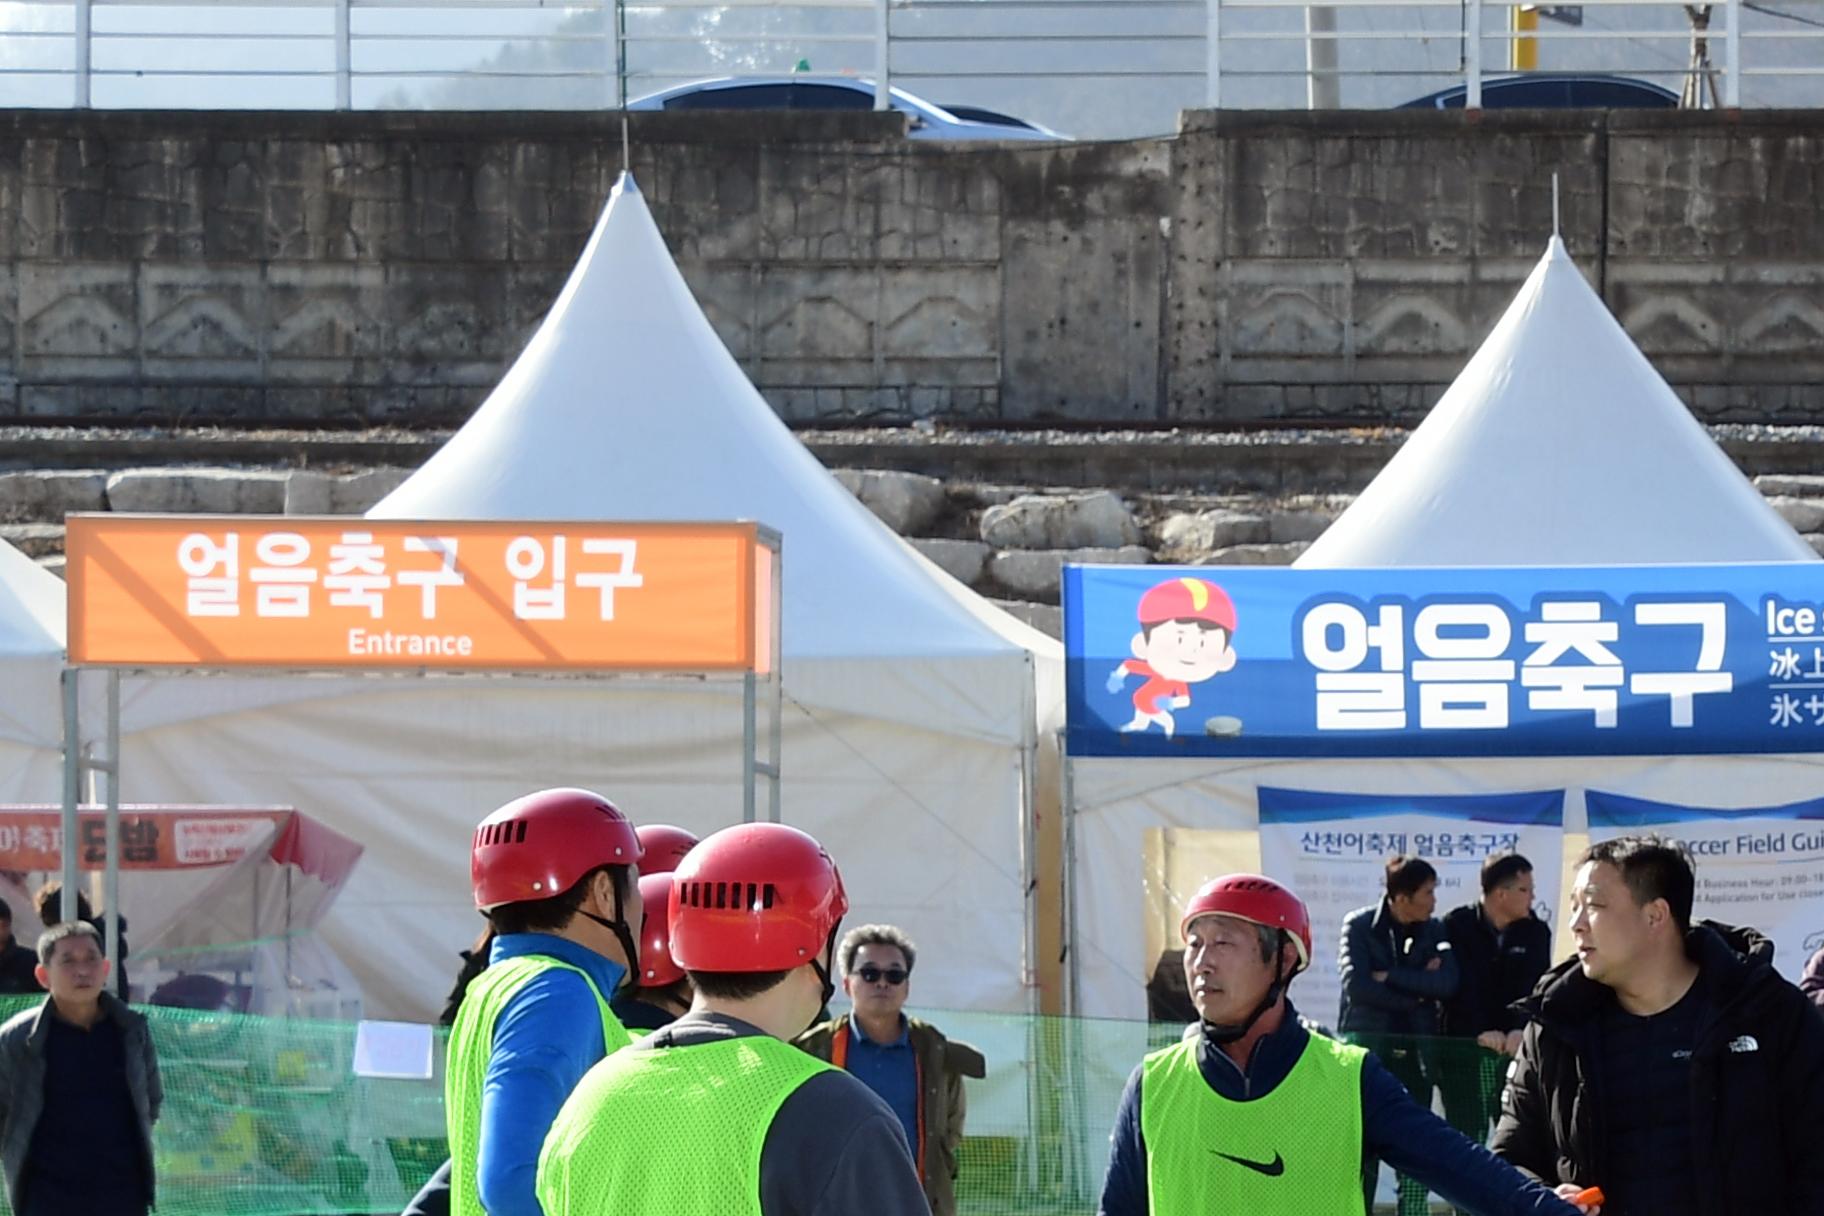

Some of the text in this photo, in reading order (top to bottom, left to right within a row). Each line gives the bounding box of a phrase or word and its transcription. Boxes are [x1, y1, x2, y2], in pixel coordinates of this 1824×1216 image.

[178, 533, 642, 620] 얼음축구 입구
[1767, 600, 1815, 635] Ice
[348, 628, 473, 656] Entrance
[1303, 602, 1733, 729] 얼음축구
[1301, 832, 1407, 855] 산천어축제
[1676, 838, 1730, 856] occer
[1736, 832, 1785, 854] Field
